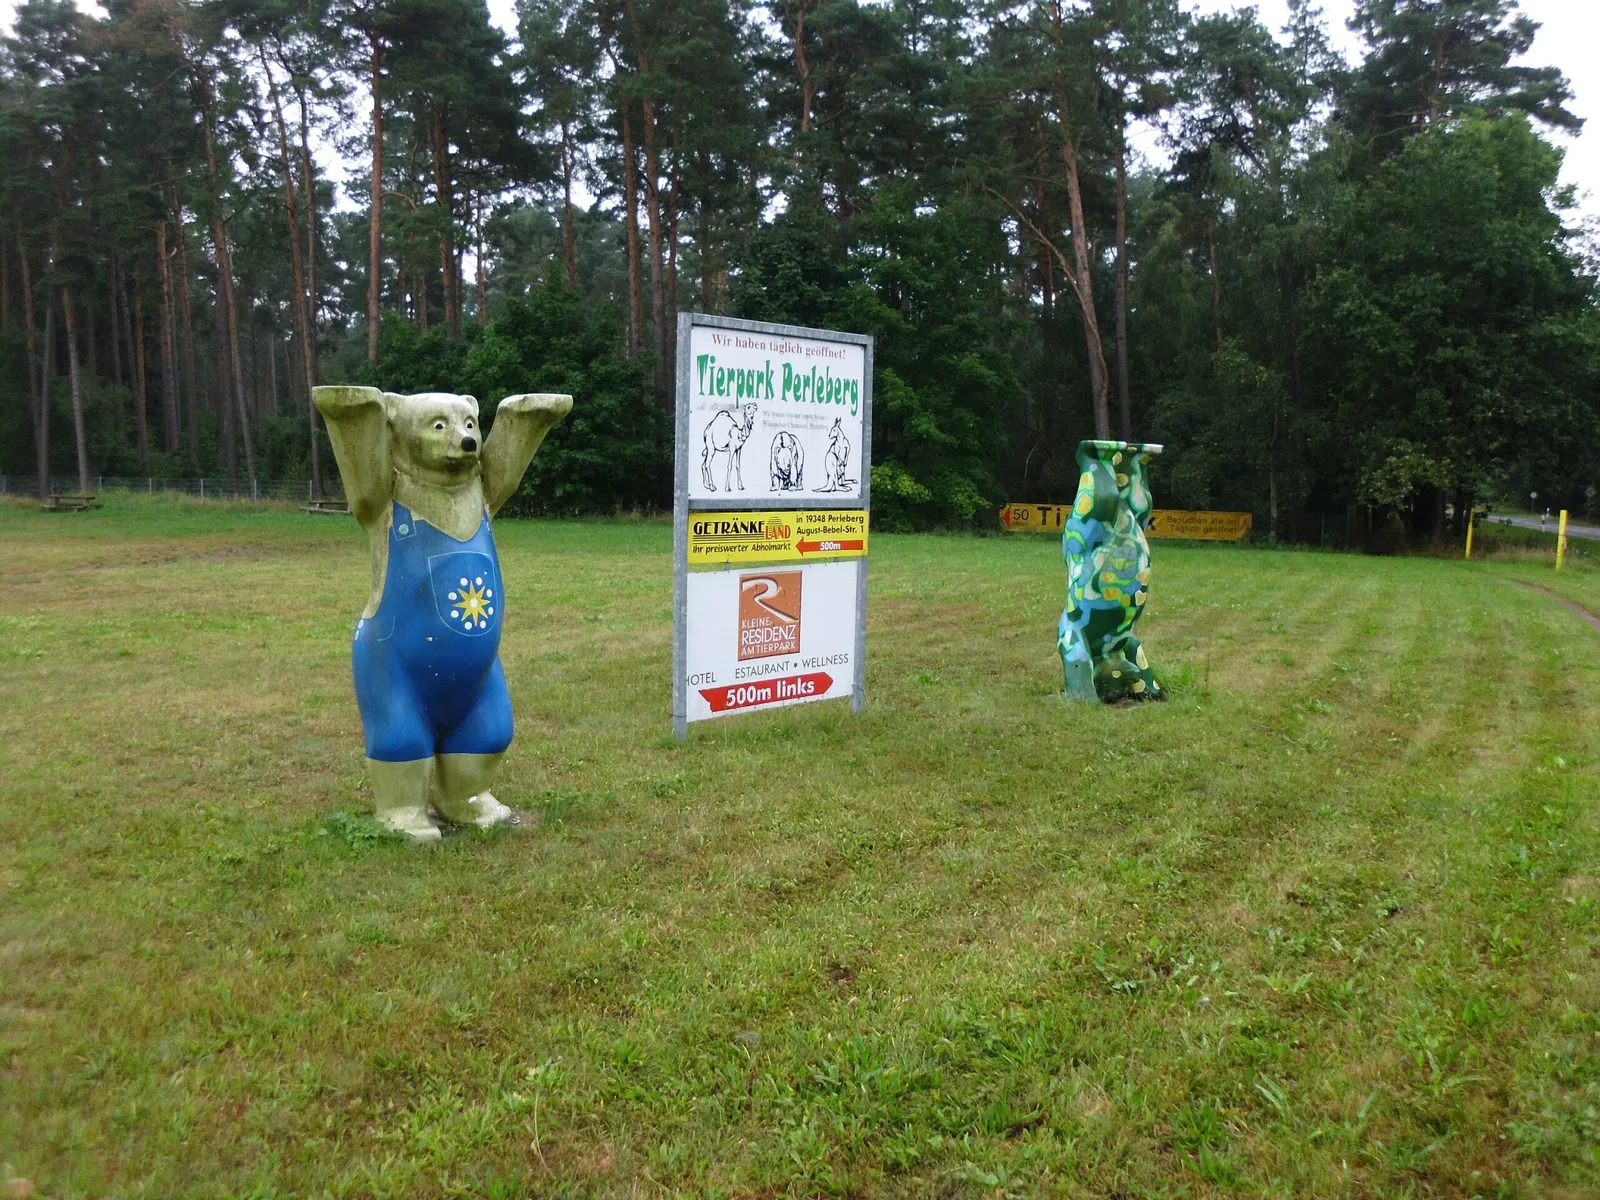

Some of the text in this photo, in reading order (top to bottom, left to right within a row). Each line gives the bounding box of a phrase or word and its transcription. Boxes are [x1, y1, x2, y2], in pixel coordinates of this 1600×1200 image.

[712, 333, 847, 360] Wir haben täglich geöffnet!
[696, 353, 859, 417] Tierpark Perleberg
[796, 513, 864, 524] in 19348 Perleberg
[1012, 508, 1030, 521] 50
[693, 517, 791, 540] GETRÄNKE LAND
[796, 525, 864, 536] August-Bebel-Str. 1
[693, 542, 791, 555] Ihr preiswerter Abholmarkt
[820, 541, 841, 550] 500m
[741, 616, 770, 629] KLEINE
[741, 624, 796, 646] RESIDENZ
[741, 640, 796, 656] AM TIERPARK
[801, 653, 849, 669] WELLNESS
[726, 677, 815, 707] 500m links
